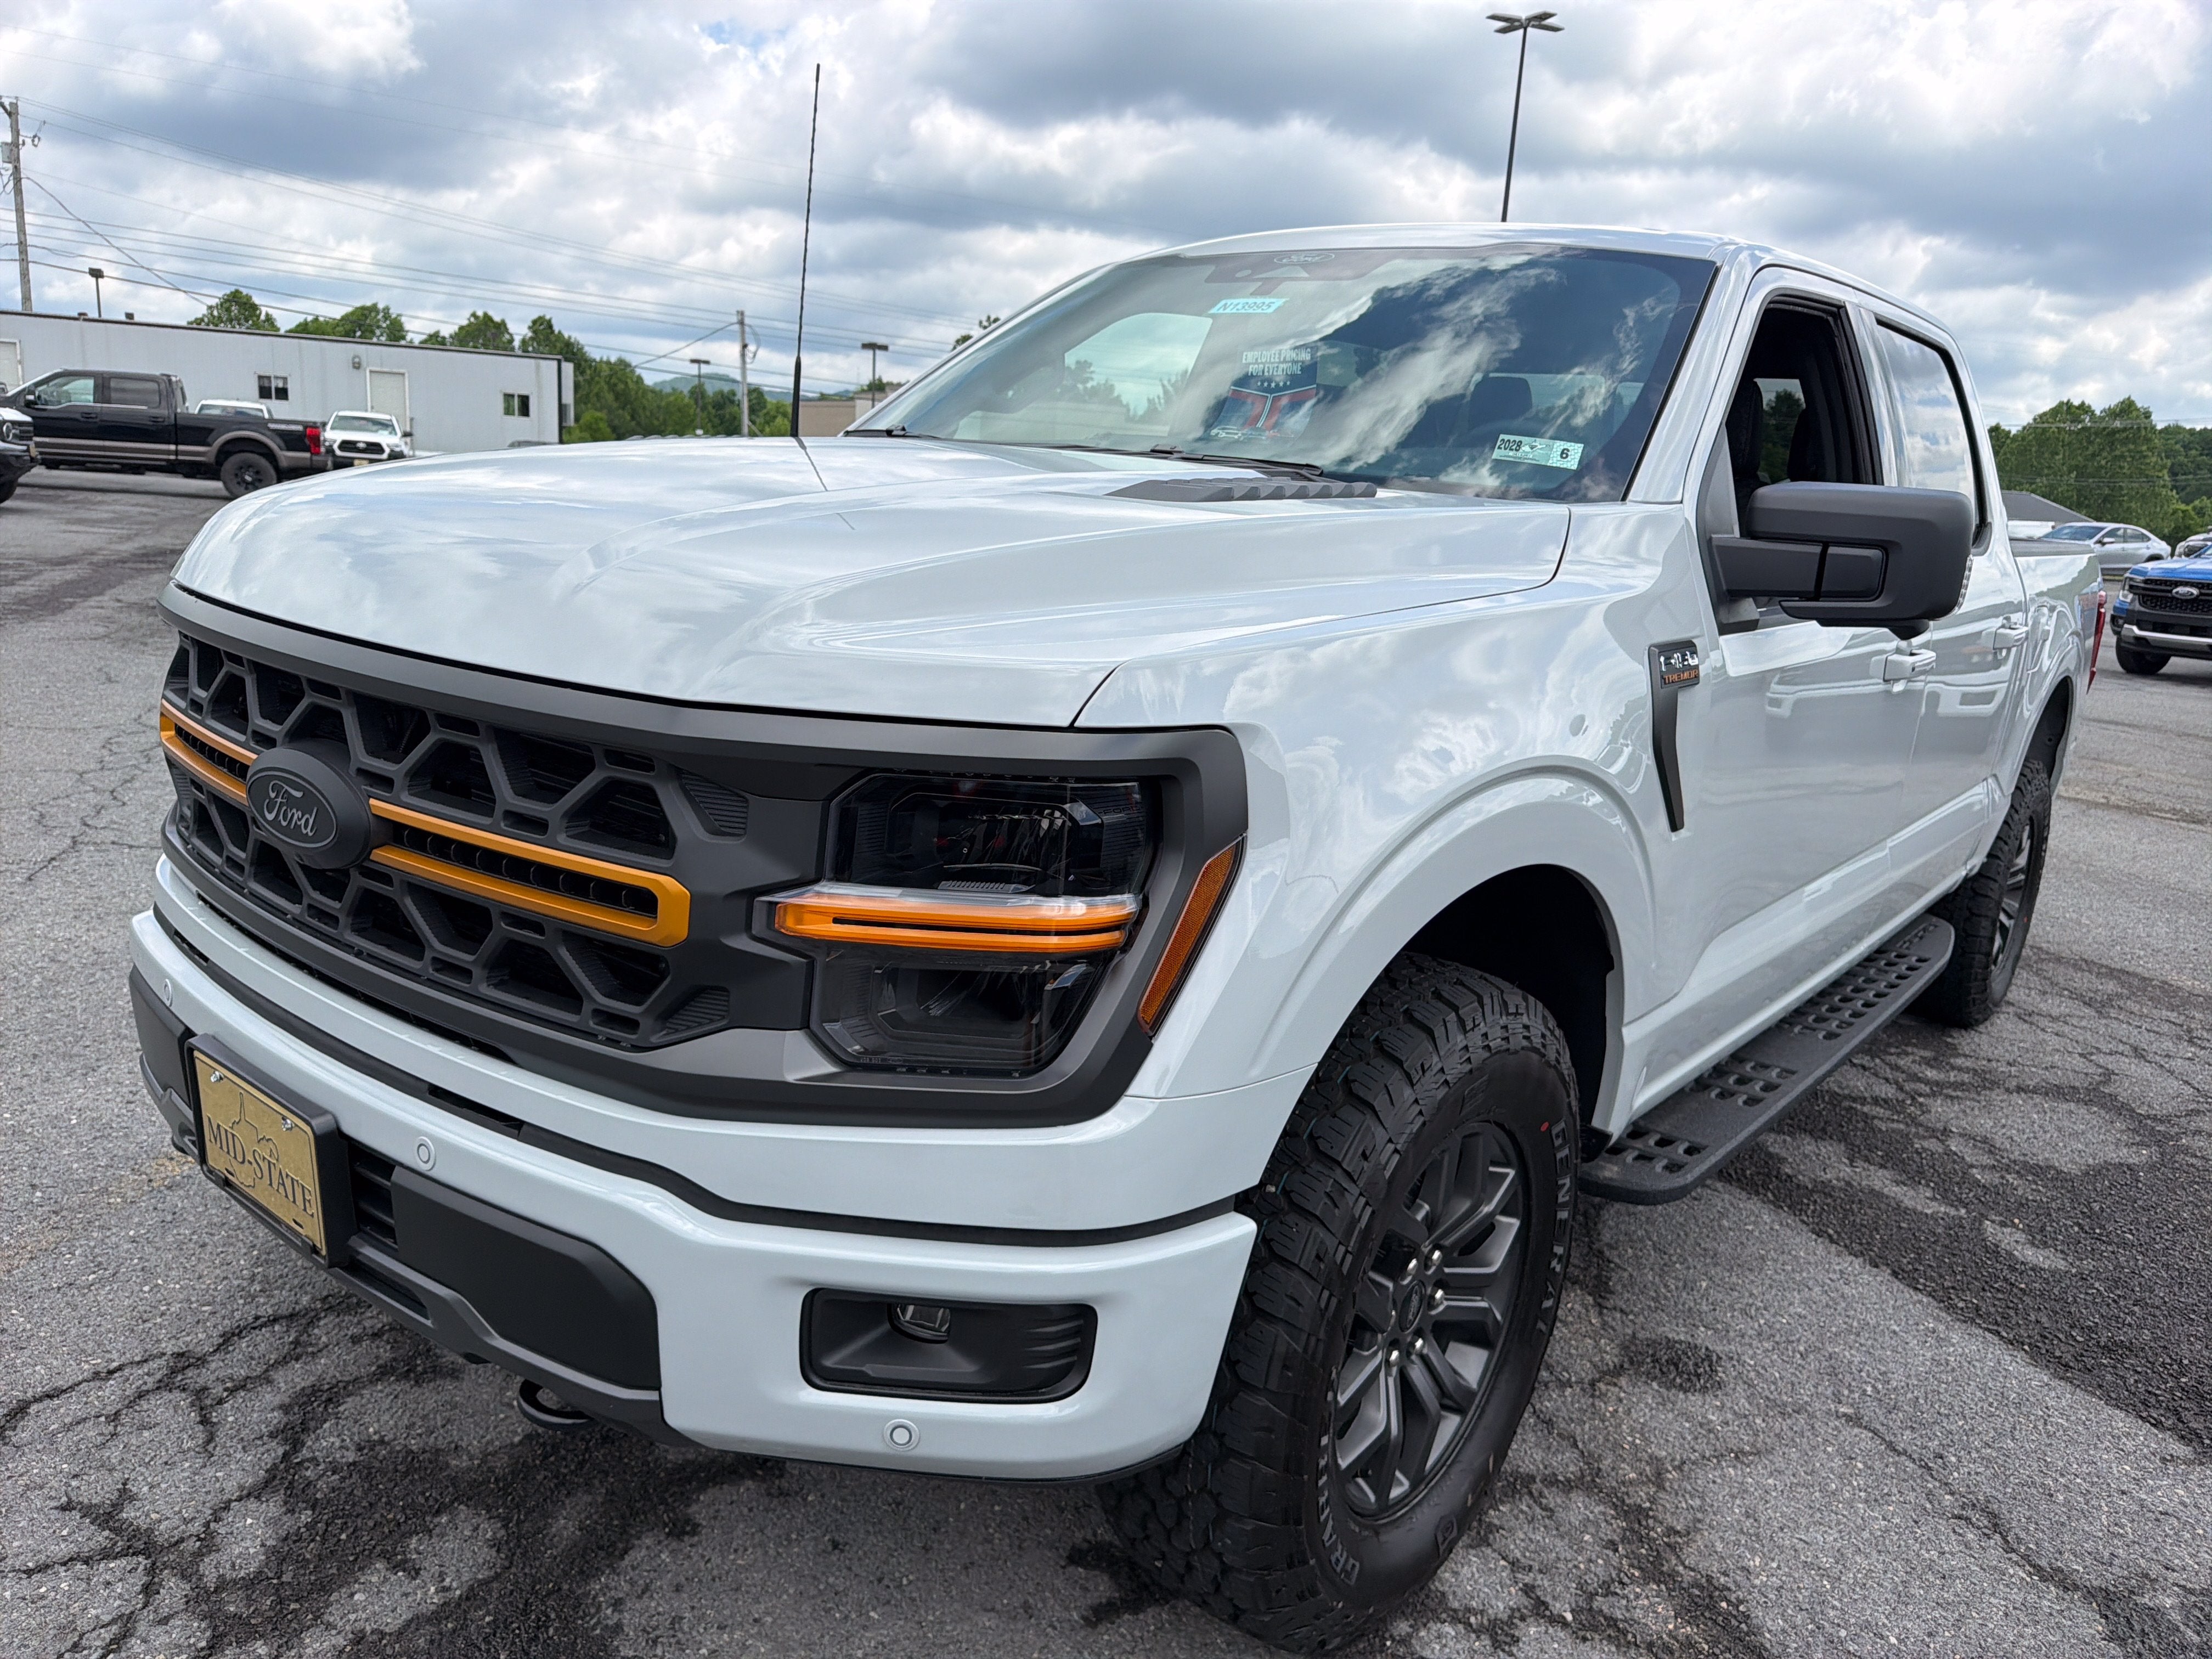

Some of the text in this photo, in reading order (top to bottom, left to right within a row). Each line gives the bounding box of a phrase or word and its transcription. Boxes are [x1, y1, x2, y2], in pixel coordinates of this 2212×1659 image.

[1217, 301, 1276, 312] N13995
[1242, 348, 1311, 363] EMPLOYEE PRICING
[1248, 362, 1302, 376] FOR EVERYONE
[1497, 438, 1570, 460] 2028 6
[1664, 669, 1699, 685] TREMOR
[263, 780, 318, 837] Ford
[206, 1113, 315, 1218] MID-STATE
